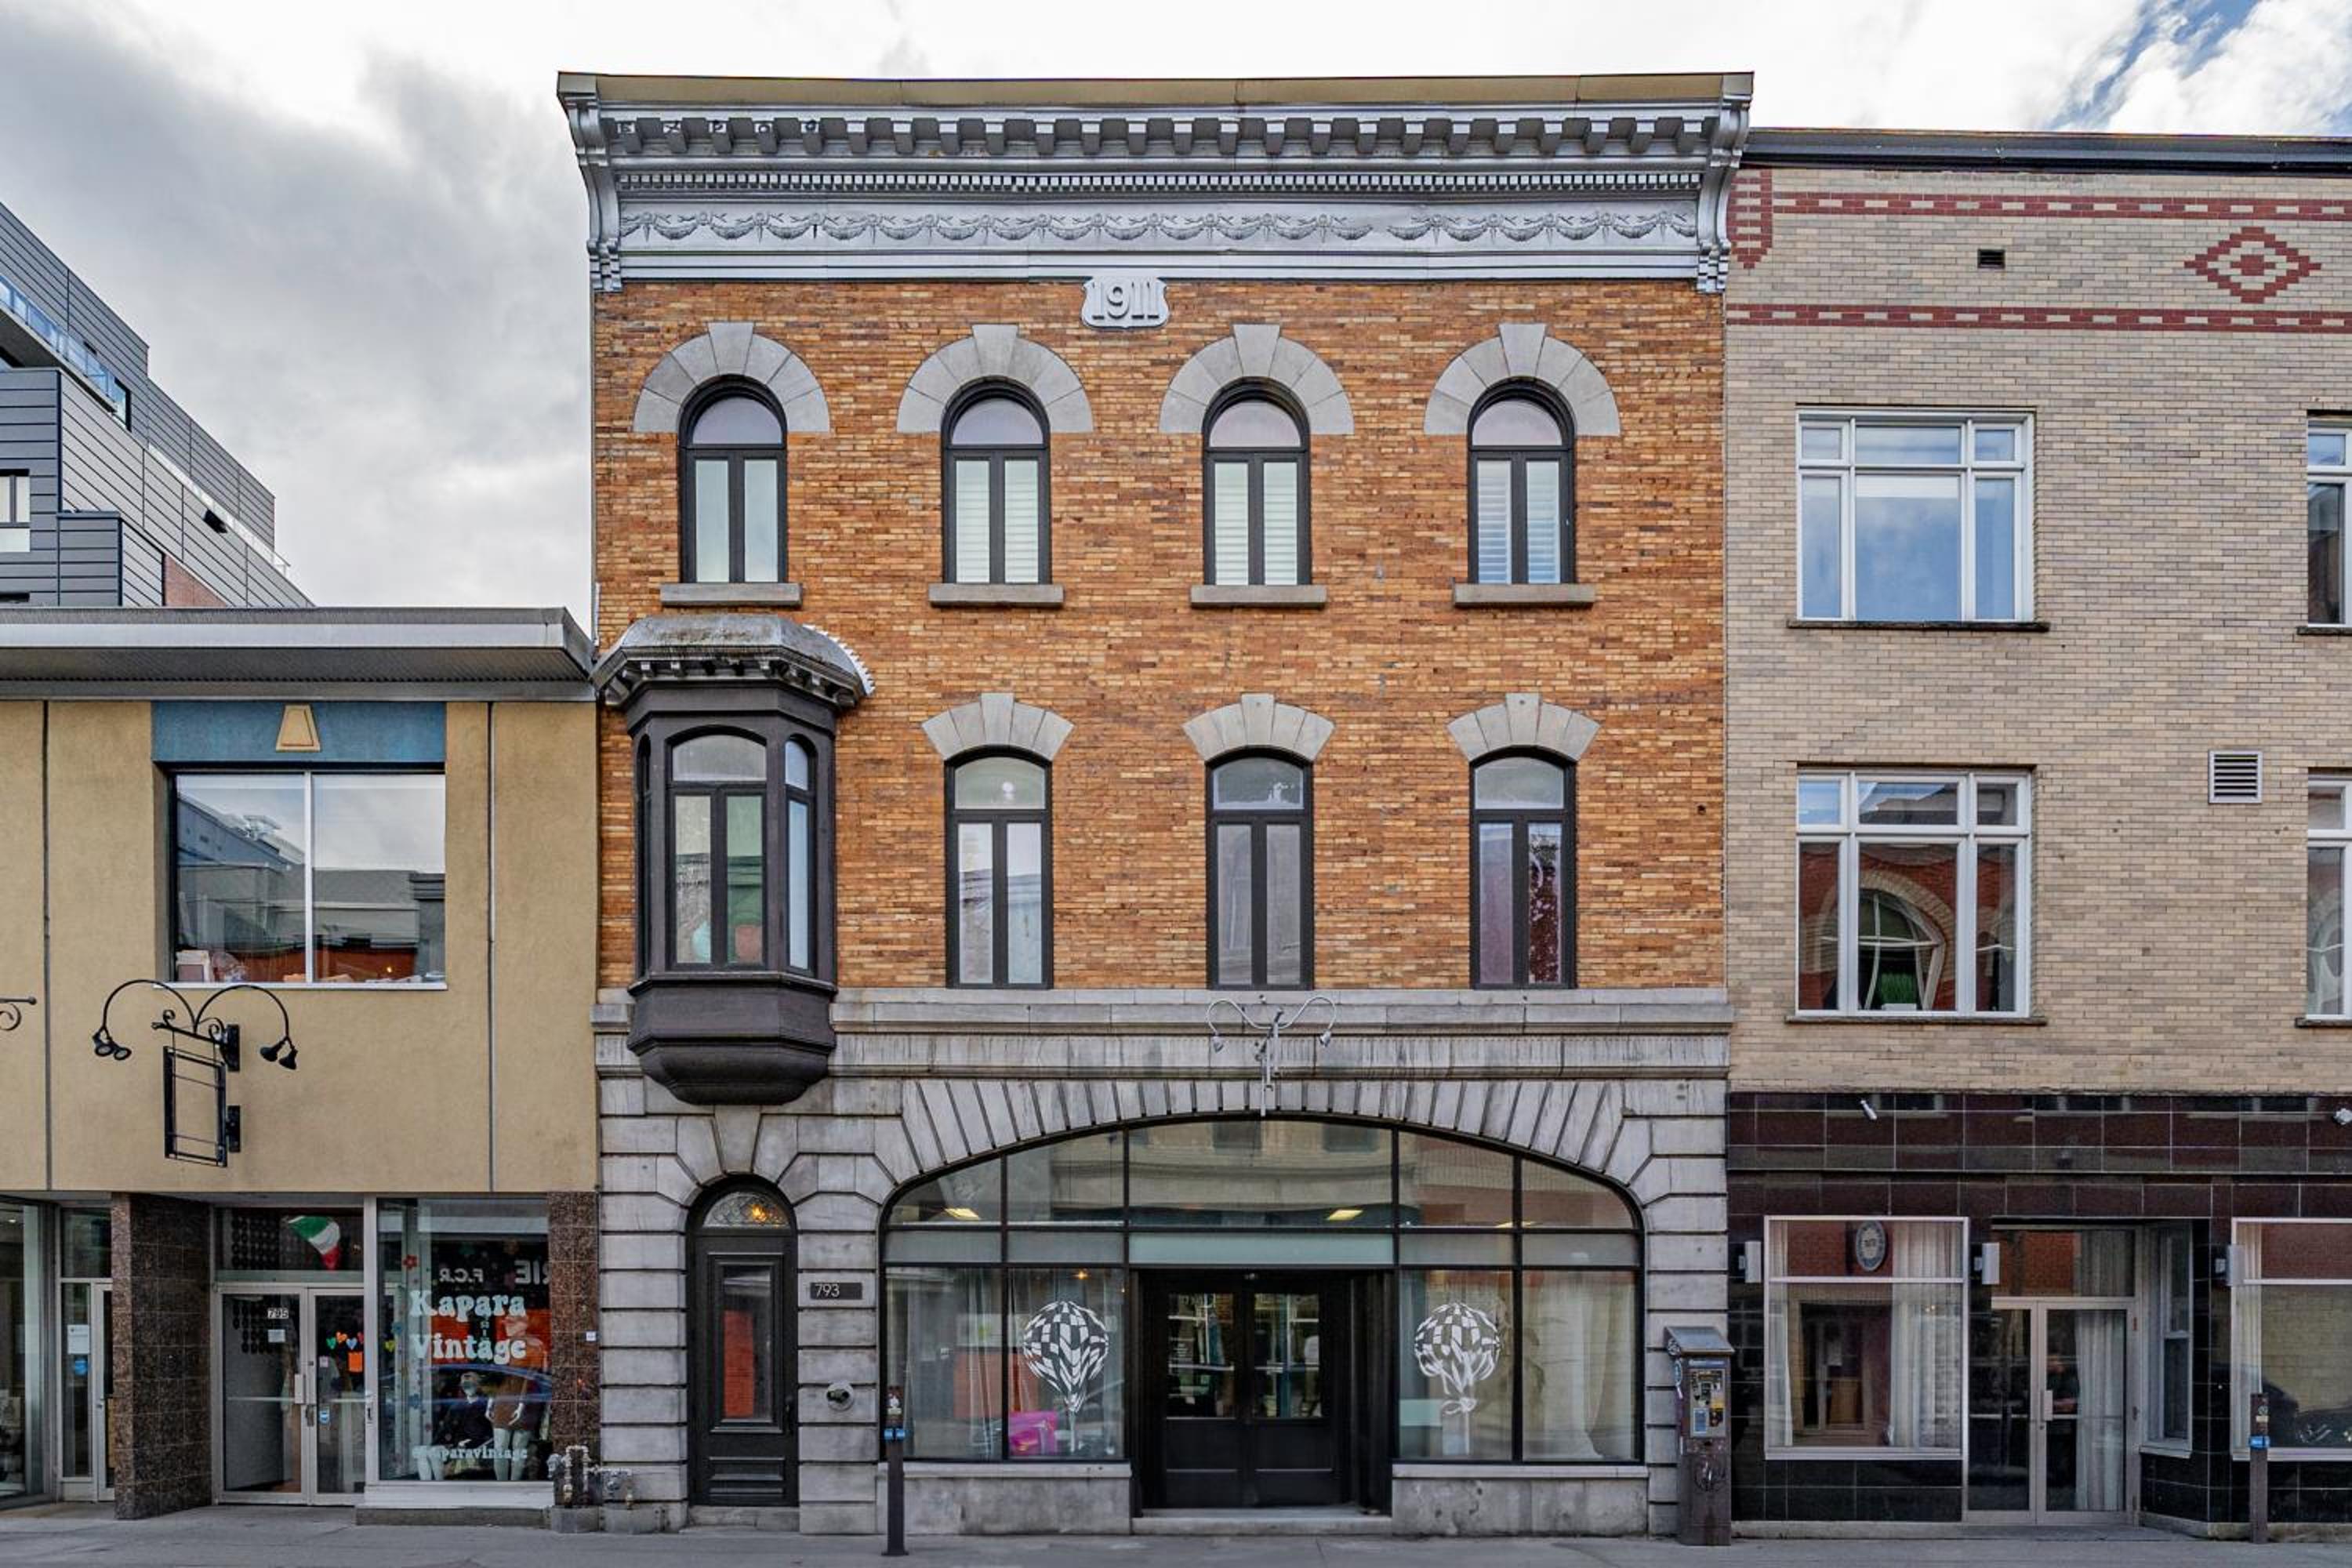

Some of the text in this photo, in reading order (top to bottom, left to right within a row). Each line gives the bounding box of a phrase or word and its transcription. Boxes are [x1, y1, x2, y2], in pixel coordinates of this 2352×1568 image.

[1091, 279, 1160, 320] 1911
[409, 1290, 527, 1323] Kapara
[815, 1283, 840, 1298] 793
[267, 1308, 289, 1319] 795
[408, 1333, 527, 1365] Vintage
